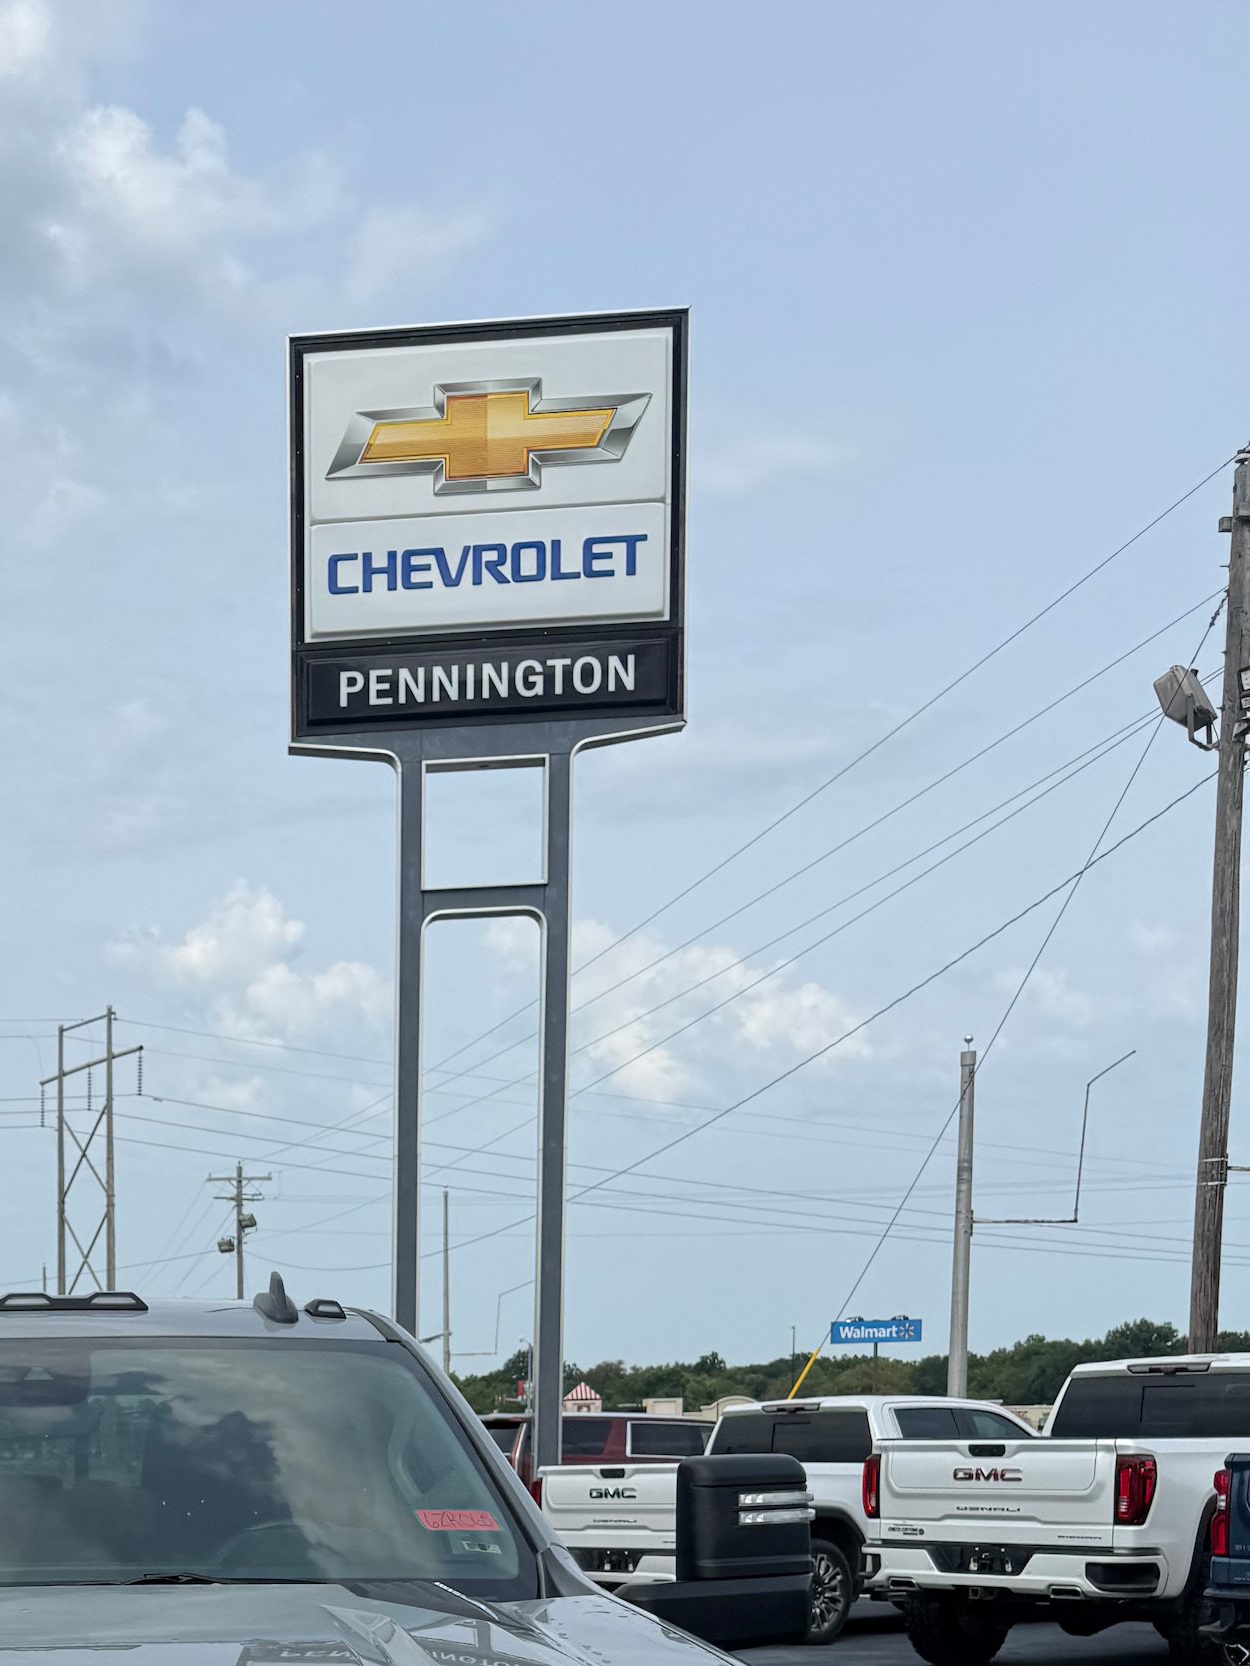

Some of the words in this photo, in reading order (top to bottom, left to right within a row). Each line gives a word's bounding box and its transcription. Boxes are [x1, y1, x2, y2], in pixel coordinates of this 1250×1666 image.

[327, 534, 648, 595] CHEVROLET
[339, 653, 636, 708] PENNINGTON
[839, 1325, 898, 1339] Walmart
[953, 1467, 1023, 1482] GMC
[589, 1487, 637, 1499] GMC
